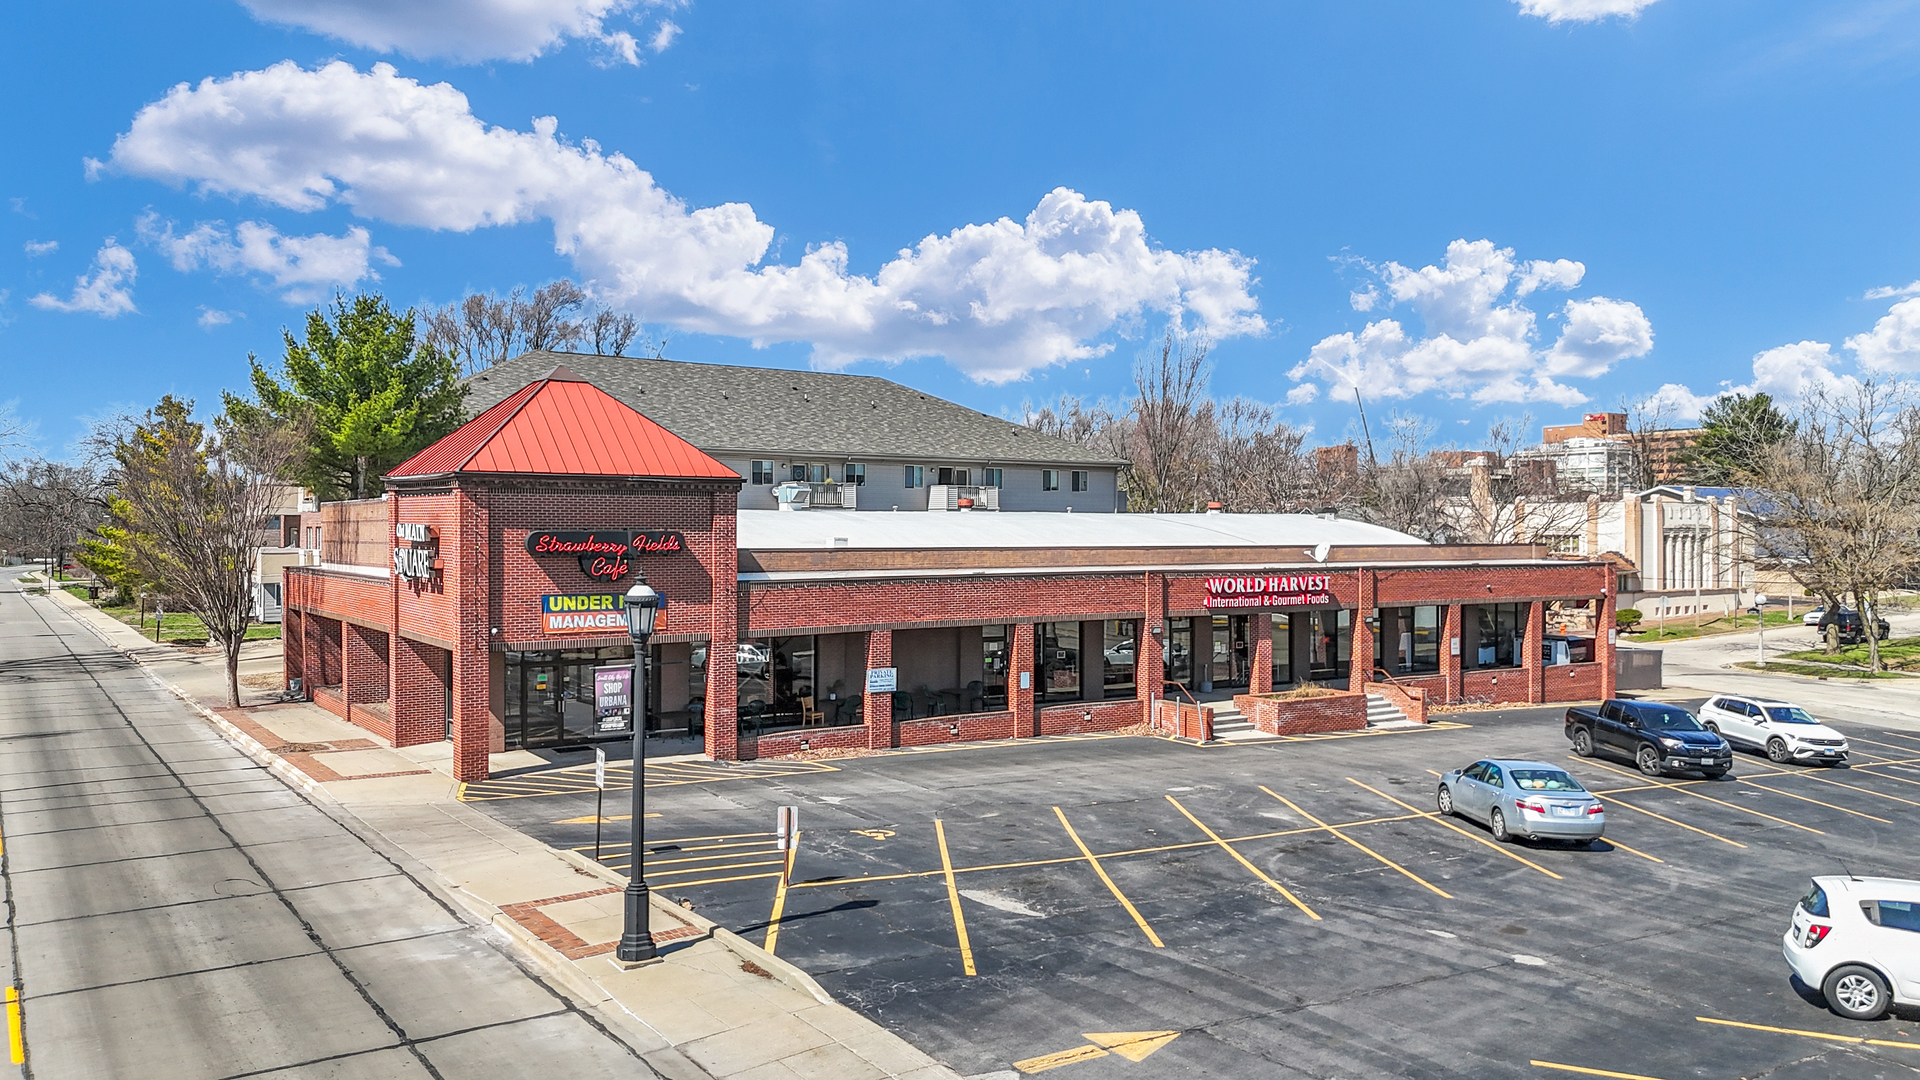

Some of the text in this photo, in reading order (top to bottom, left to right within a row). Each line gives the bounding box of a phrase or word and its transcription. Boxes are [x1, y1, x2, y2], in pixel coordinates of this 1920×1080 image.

[405, 523, 426, 542] MAIN
[535, 534, 680, 556] Strawberry Fields
[394, 547, 430, 582] SQUARE
[1209, 576, 1331, 593] WORLD HARVEST
[549, 595, 614, 612] UNDER
[1209, 593, 1329, 607] International & Gourmet Foods
[603, 682, 622, 694] SHOP
[599, 694, 627, 707] URBANA
